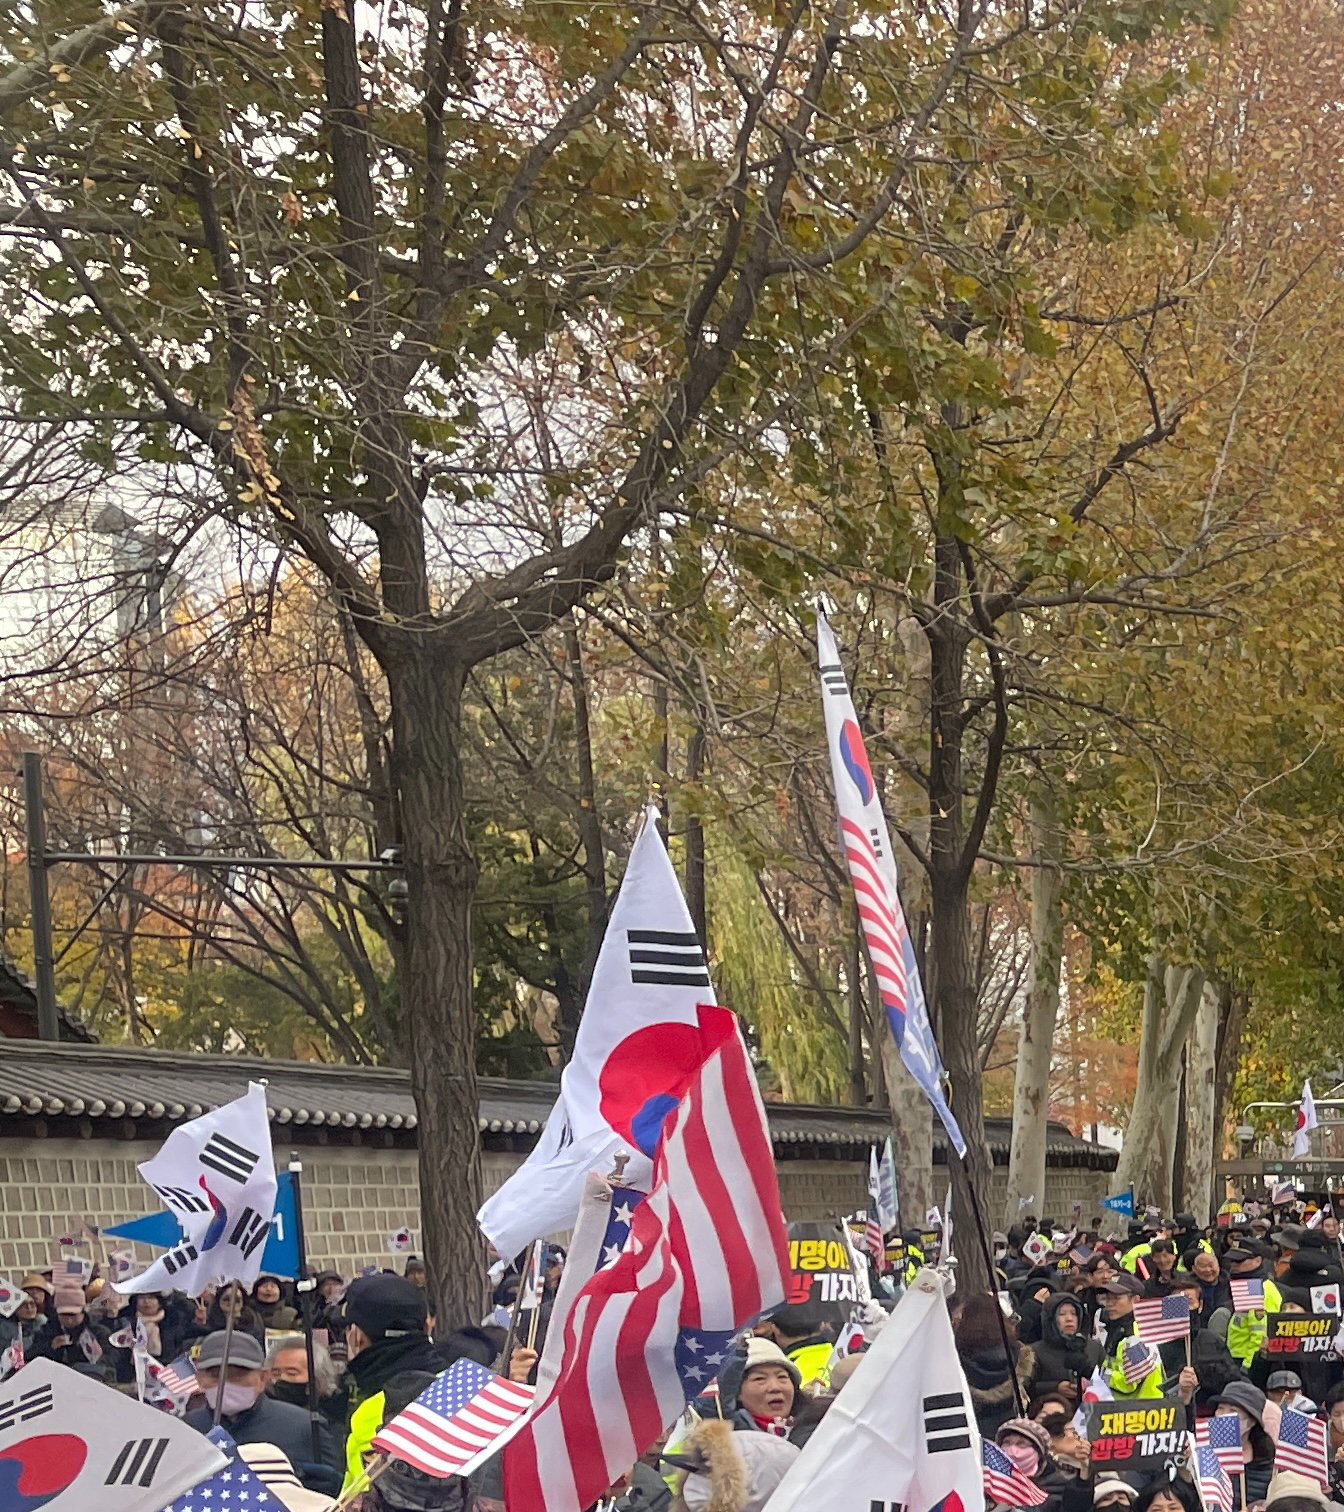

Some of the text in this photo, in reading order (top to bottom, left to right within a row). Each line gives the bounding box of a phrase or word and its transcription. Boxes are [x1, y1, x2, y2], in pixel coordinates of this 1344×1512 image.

[1275, 1318, 1332, 1337] 재명아!
[1301, 1335, 1335, 1353] 가자!
[1099, 1407, 1176, 1436] 재명아!
[1091, 1430, 1186, 1461] 깜방 가자!
